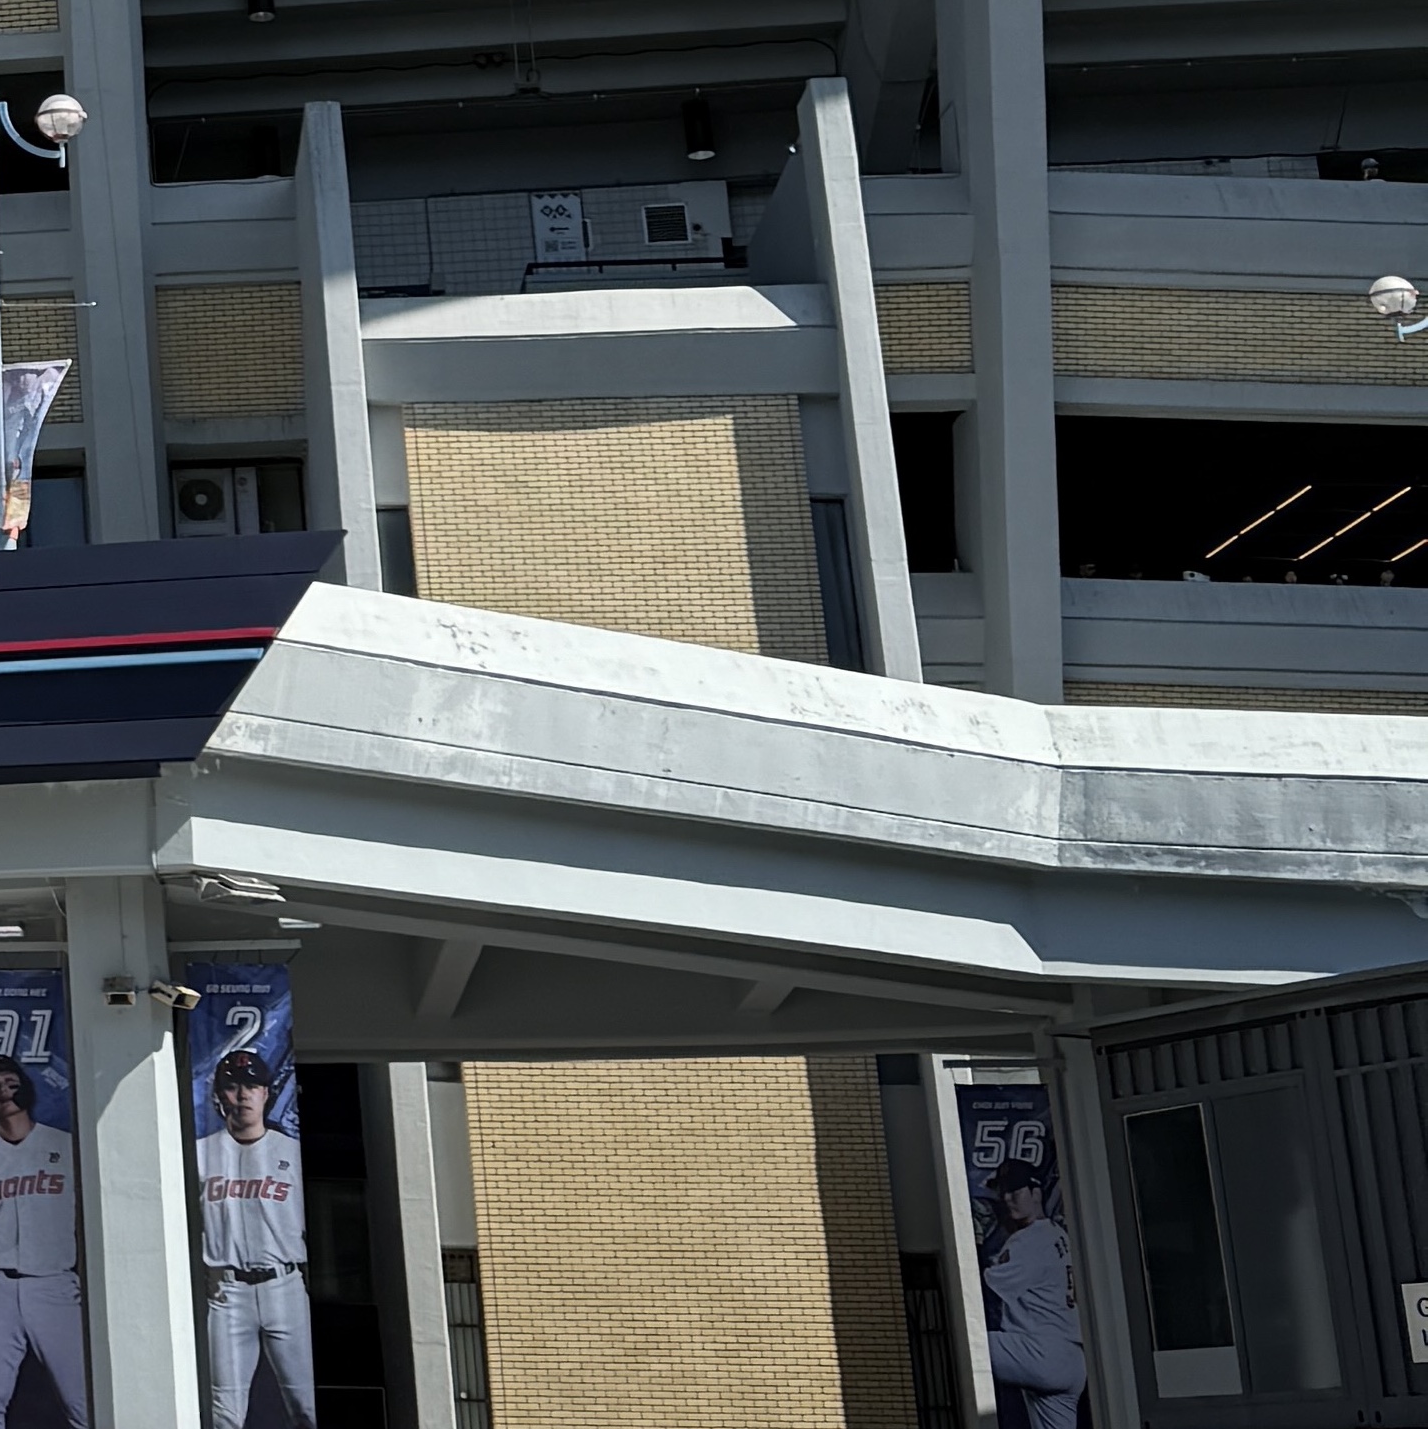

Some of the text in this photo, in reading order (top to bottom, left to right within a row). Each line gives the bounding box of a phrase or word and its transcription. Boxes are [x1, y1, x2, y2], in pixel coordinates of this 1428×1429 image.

[220, 1005, 262, 1054] 2
[972, 1120, 1046, 1169] 56
[207, 1174, 293, 1204] Giants
